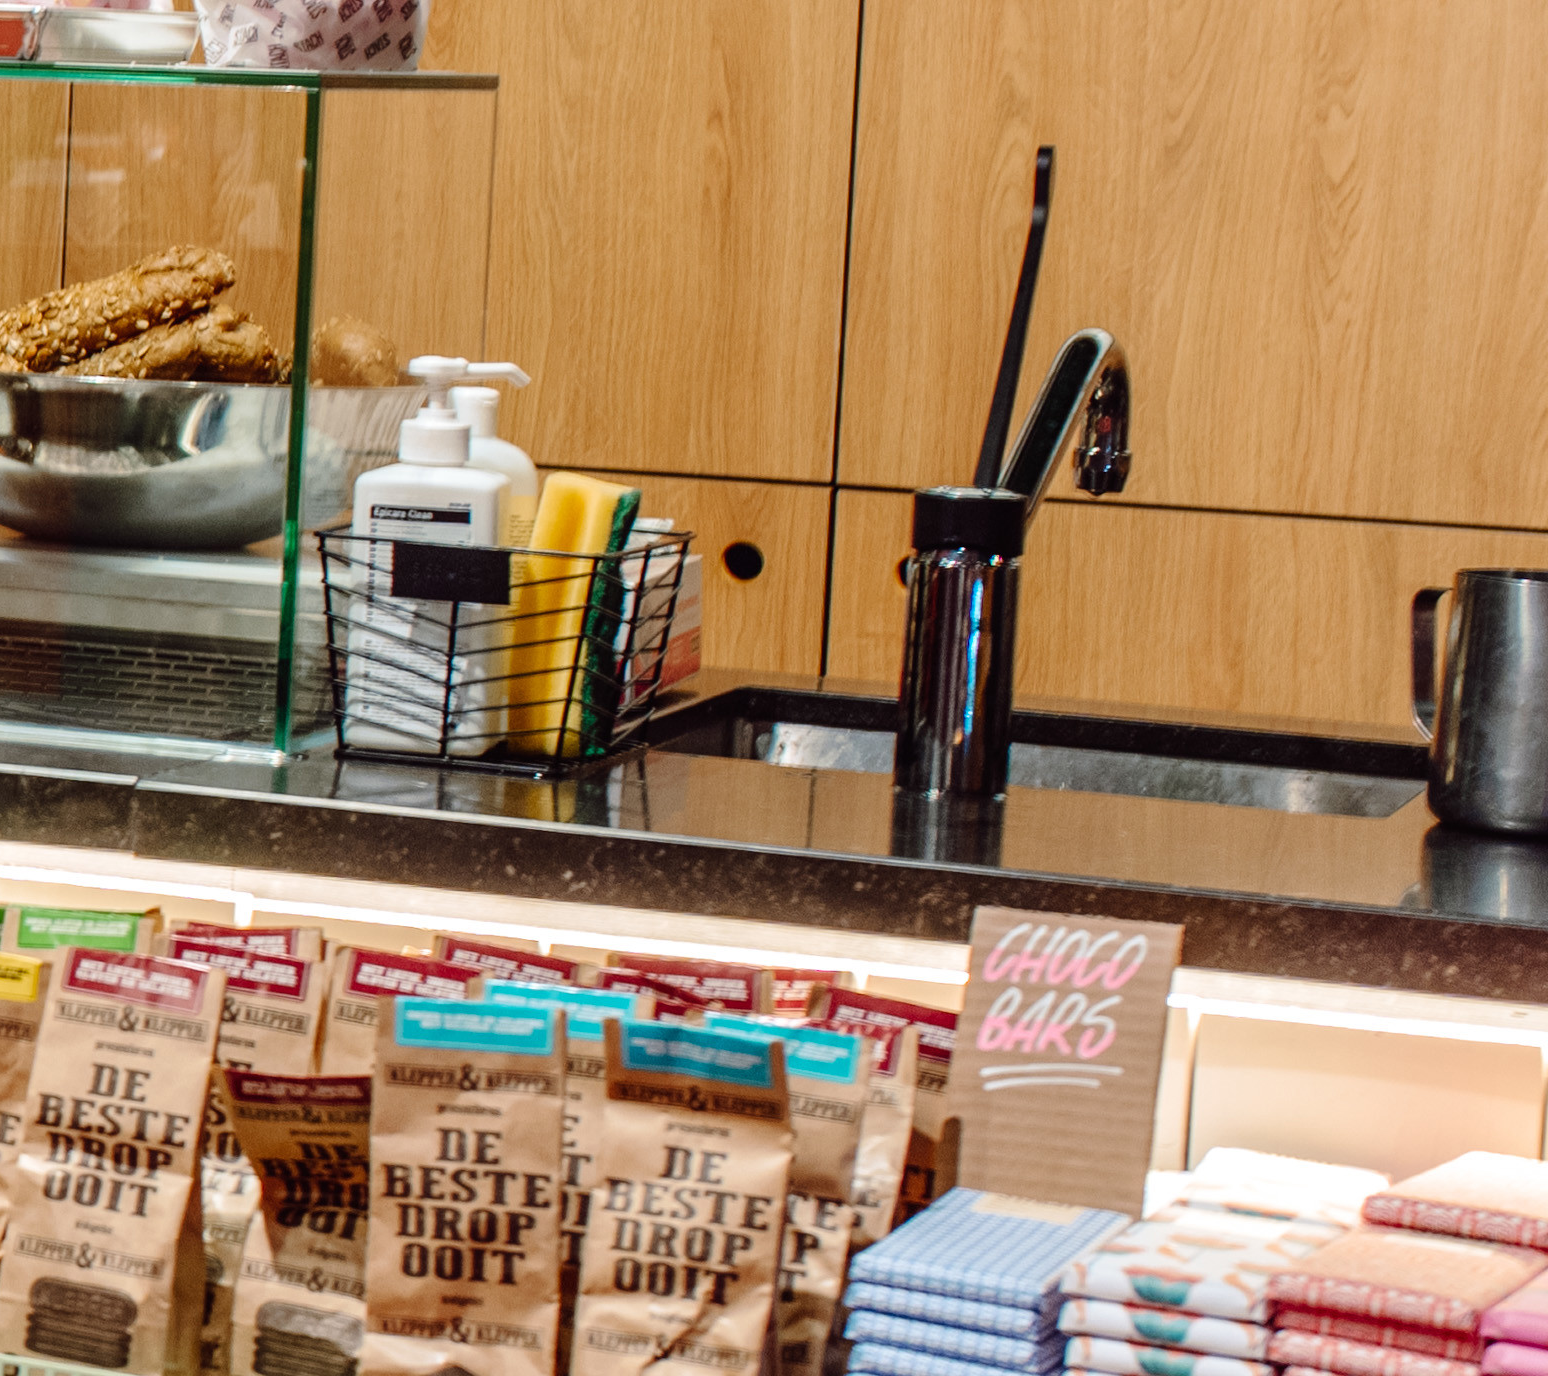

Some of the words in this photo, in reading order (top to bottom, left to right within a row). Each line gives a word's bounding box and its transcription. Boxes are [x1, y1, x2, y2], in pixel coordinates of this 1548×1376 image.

[983, 923, 1148, 990] CHOCO
[976, 987, 1123, 1059] BARS
[438, 1129, 502, 1164] DE
[383, 1163, 551, 1208] BESTE
[398, 1205, 535, 1245] DROP
[401, 1243, 525, 1285] OOIT
